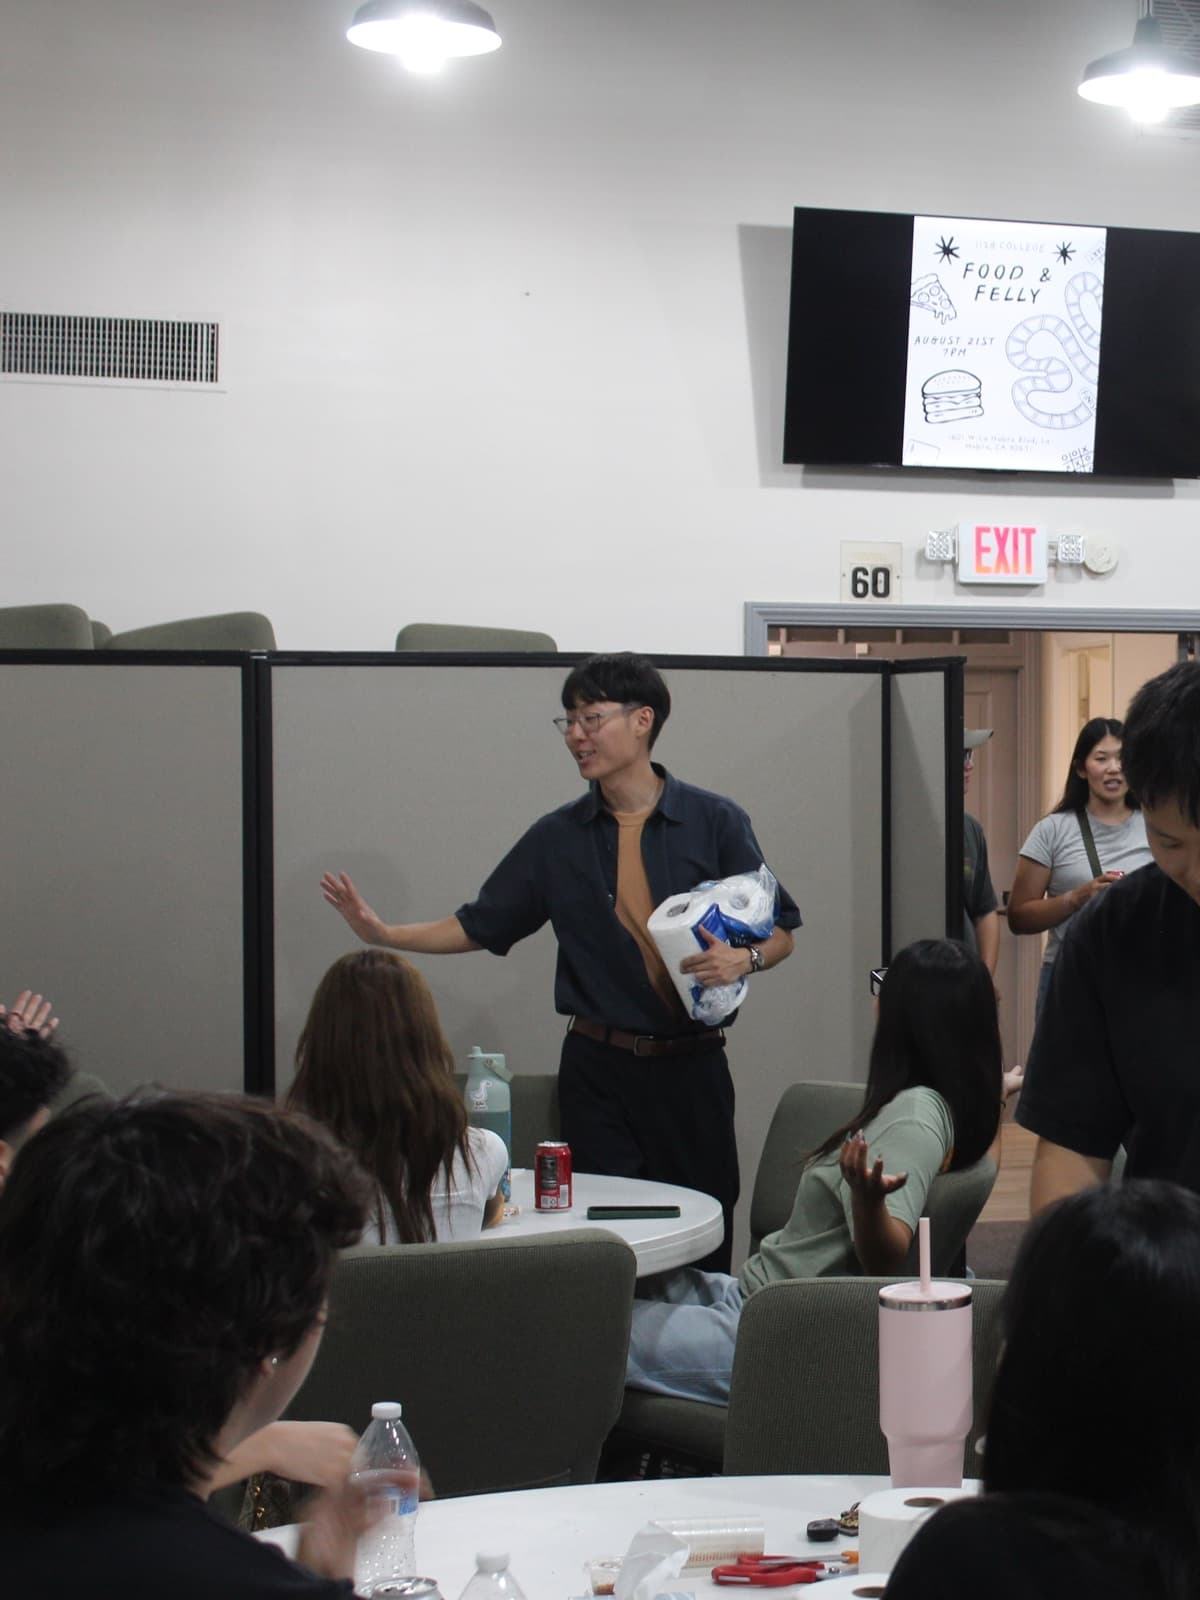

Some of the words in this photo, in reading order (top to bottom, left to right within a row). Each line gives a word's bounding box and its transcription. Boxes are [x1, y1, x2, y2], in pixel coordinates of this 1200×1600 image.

[962, 261, 1024, 281] FOOD
[1038, 267, 1051, 283] &
[974, 284, 1041, 304] FELLY
[914, 335, 960, 346] AUGUST
[967, 336, 995, 346] 21ST
[943, 347, 967, 357] 7PM
[975, 525, 1036, 575] EXIT
[851, 566, 890, 598] 60
